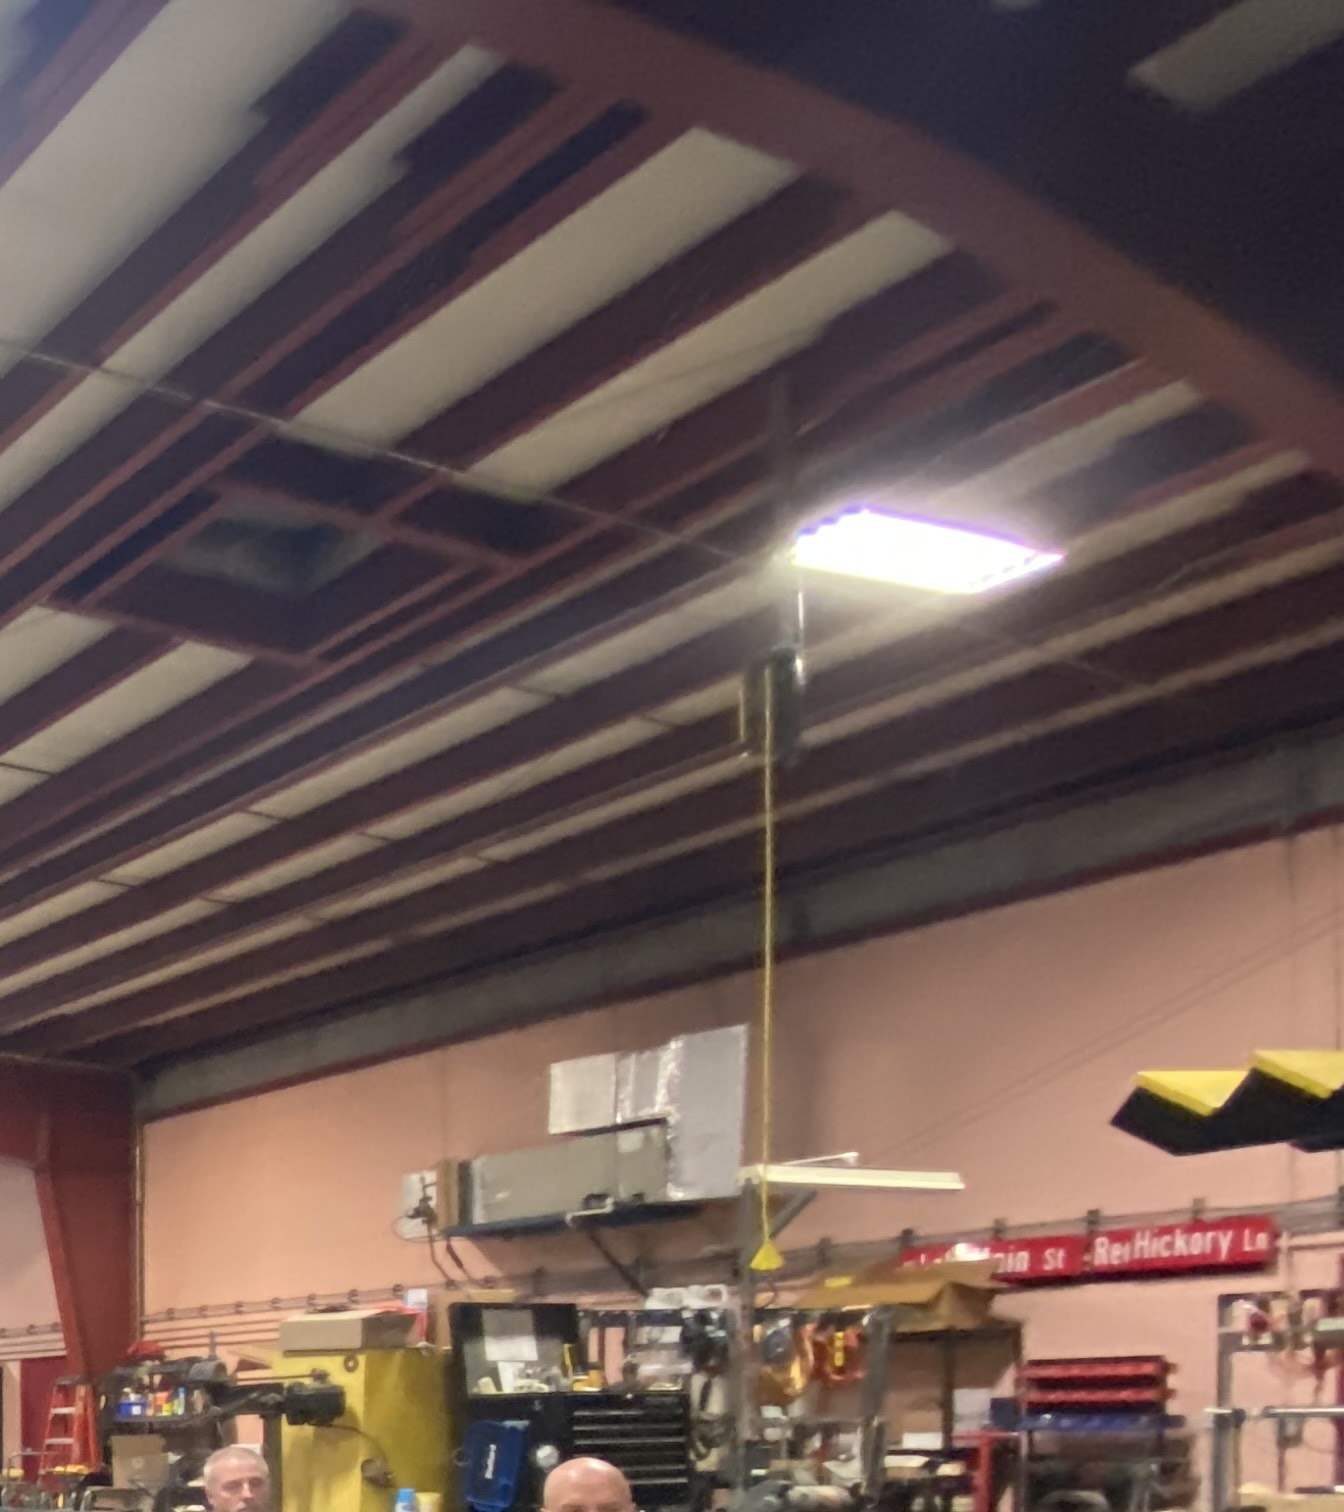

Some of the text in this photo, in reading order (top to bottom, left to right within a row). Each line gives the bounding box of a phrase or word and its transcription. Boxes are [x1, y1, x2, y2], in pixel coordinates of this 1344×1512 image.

[1134, 1228, 1269, 1261] Hickory Ln
[1042, 1247, 1066, 1271] St
